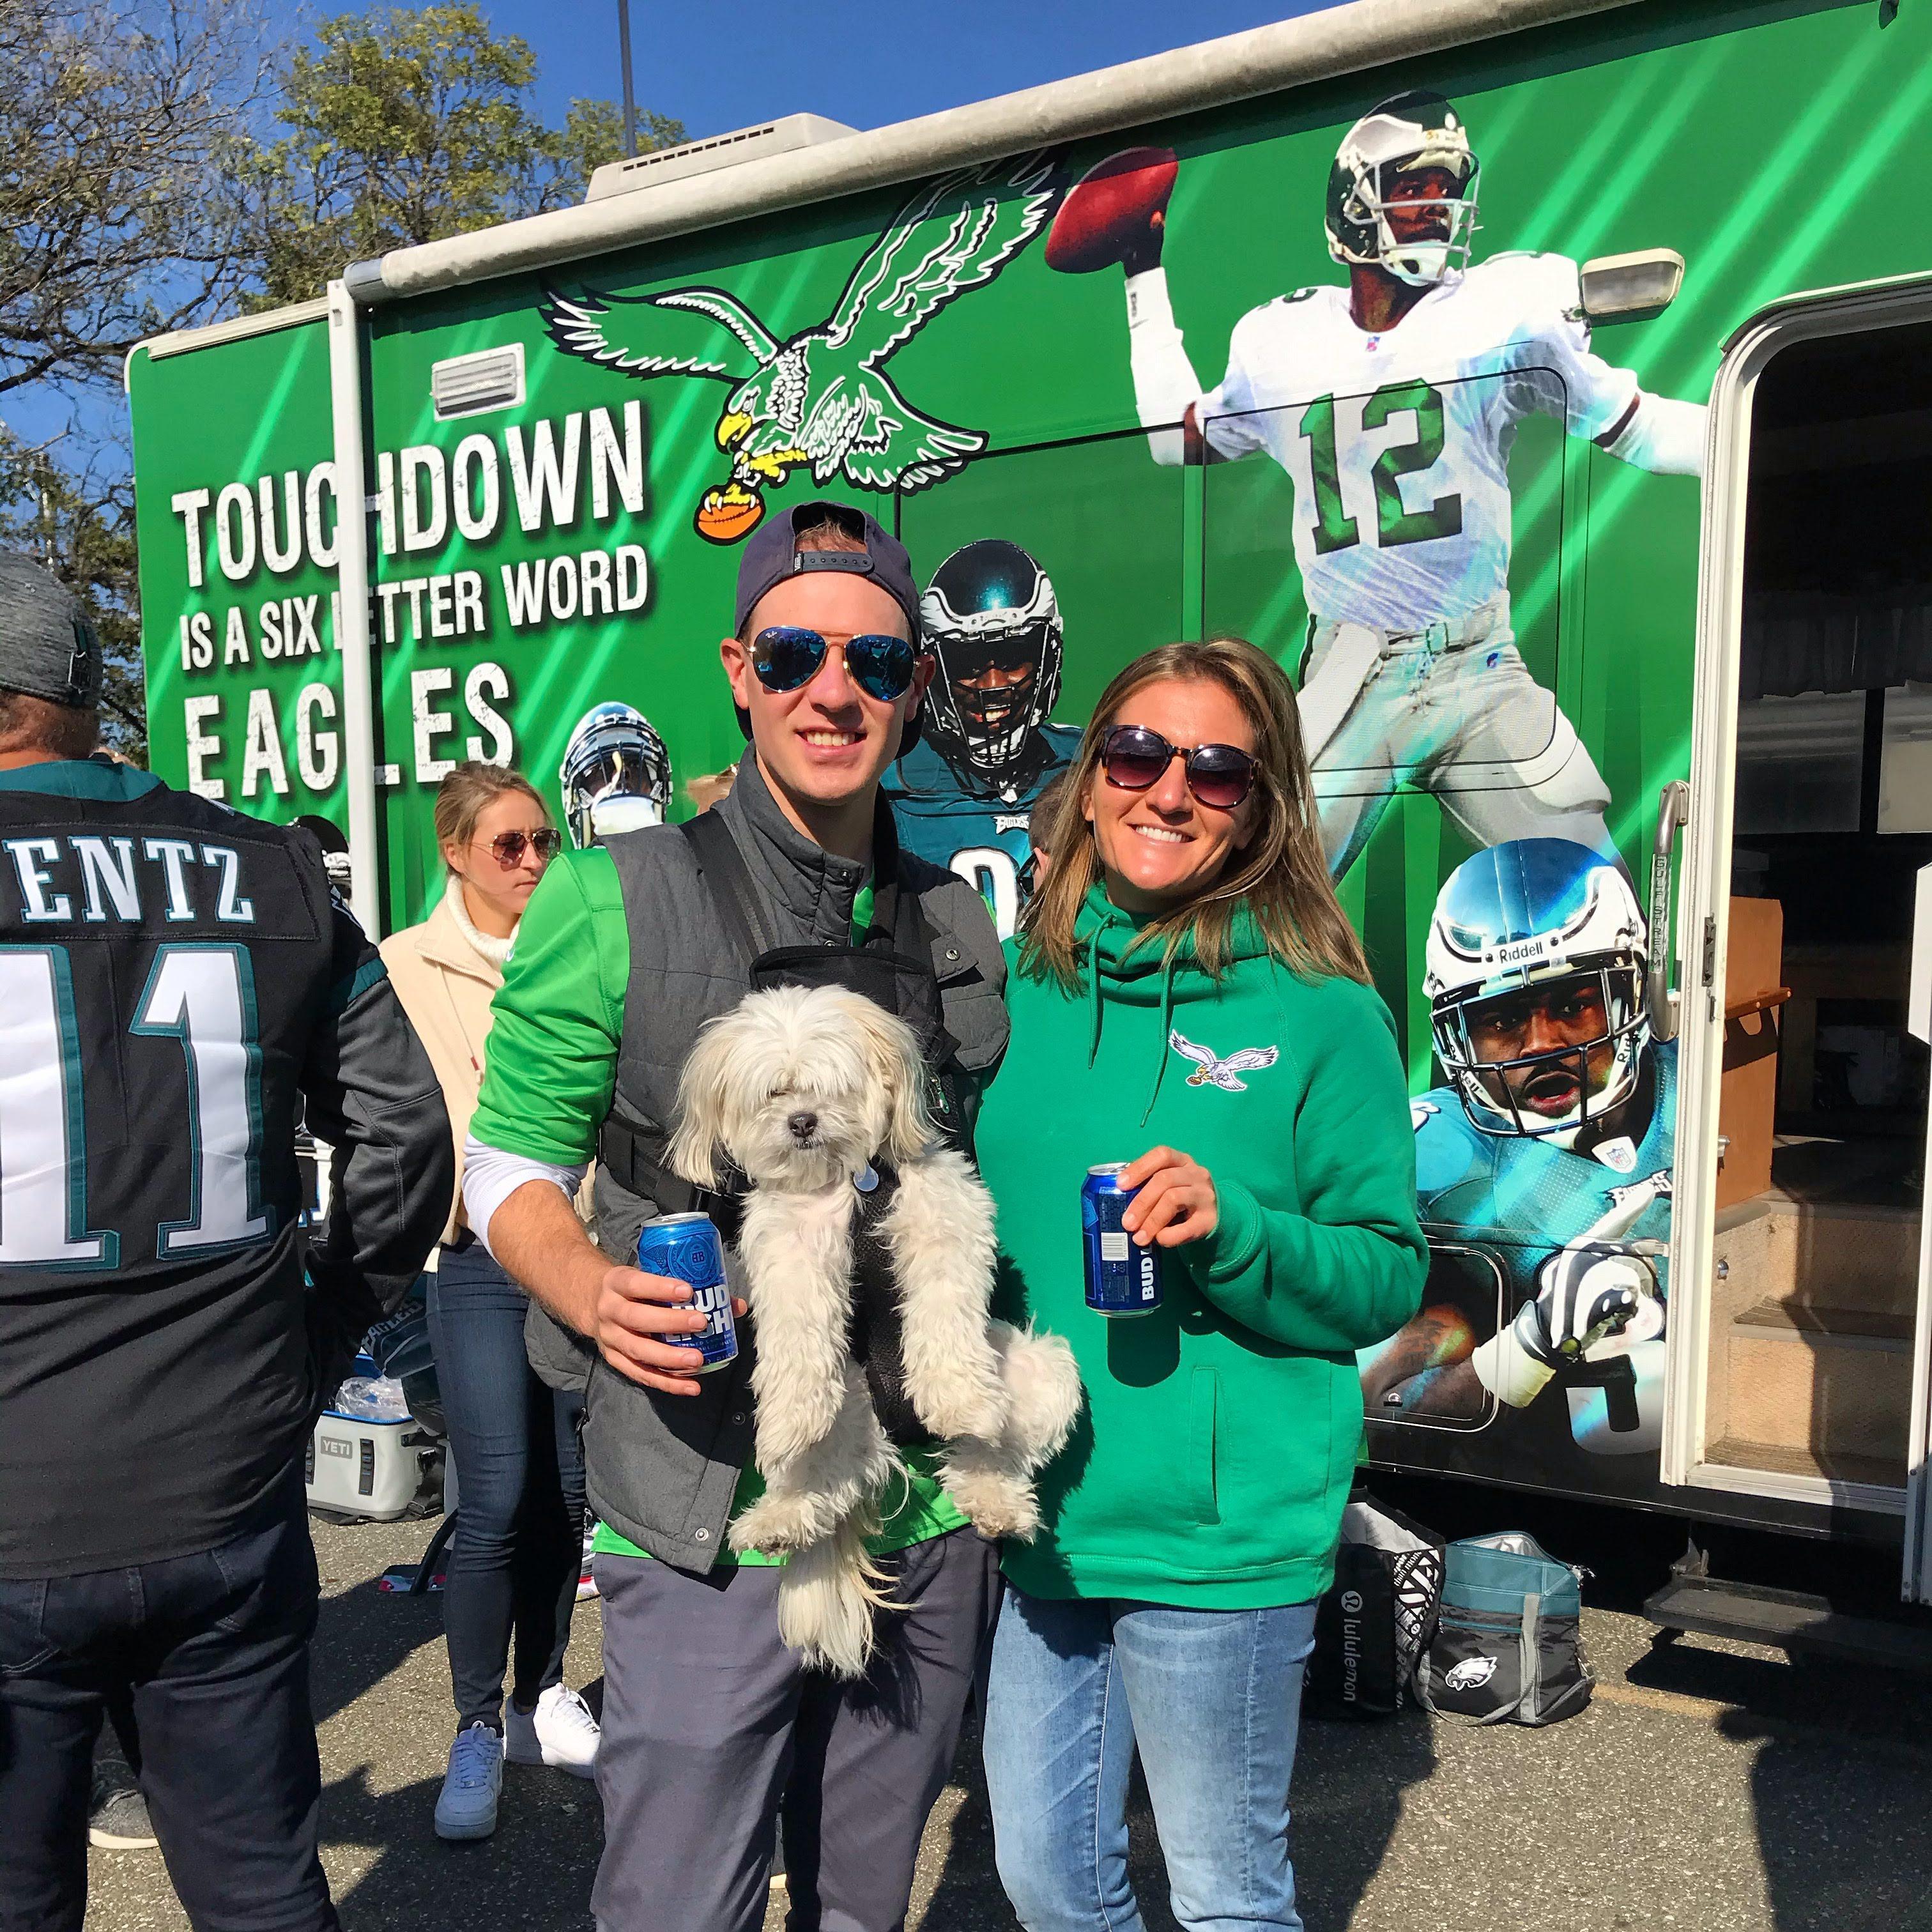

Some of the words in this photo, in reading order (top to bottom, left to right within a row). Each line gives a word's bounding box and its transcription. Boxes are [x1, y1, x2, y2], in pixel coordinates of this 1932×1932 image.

[1300, 378, 1463, 555] 12
[180, 610, 212, 671] IS
[224, 605, 250, 665] A
[259, 594, 321, 661] SIX
[331, 570, 486, 650] LTTER
[501, 544, 649, 627] WORD
[184, 662, 513, 799] EAGES
[2, 835, 255, 924] ENTZ
[1499, 941, 1544, 964] Riddell
[0, 942, 276, 1271] 11
[671, 1284, 729, 1313] UD
[1140, 1257, 1154, 1301] BUD
[323, 1439, 351, 1456] YETI
[1344, 1618, 1361, 1702] lululemon
